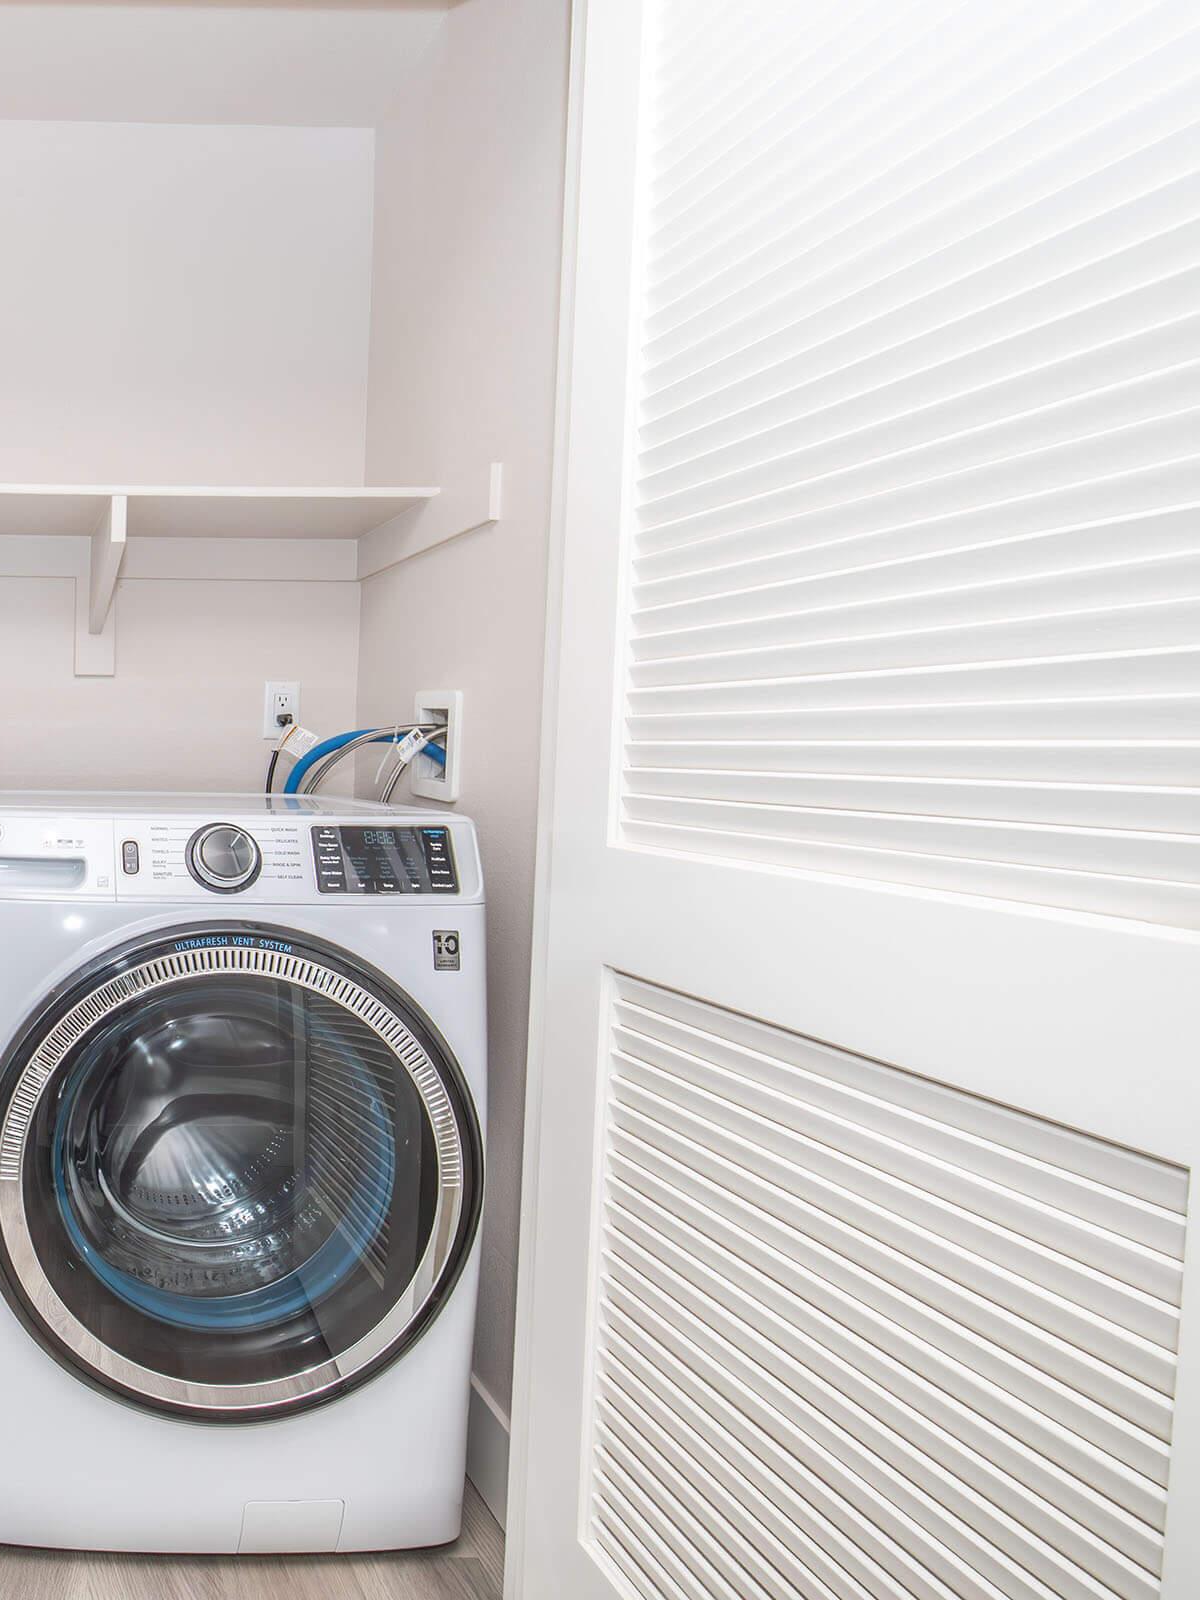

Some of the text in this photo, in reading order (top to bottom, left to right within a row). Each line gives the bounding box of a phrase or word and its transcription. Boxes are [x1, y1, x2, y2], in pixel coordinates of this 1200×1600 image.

[175, 936, 293, 953] ULTRAFRESH VENT SYSTEM
[433, 935, 459, 955] 10
